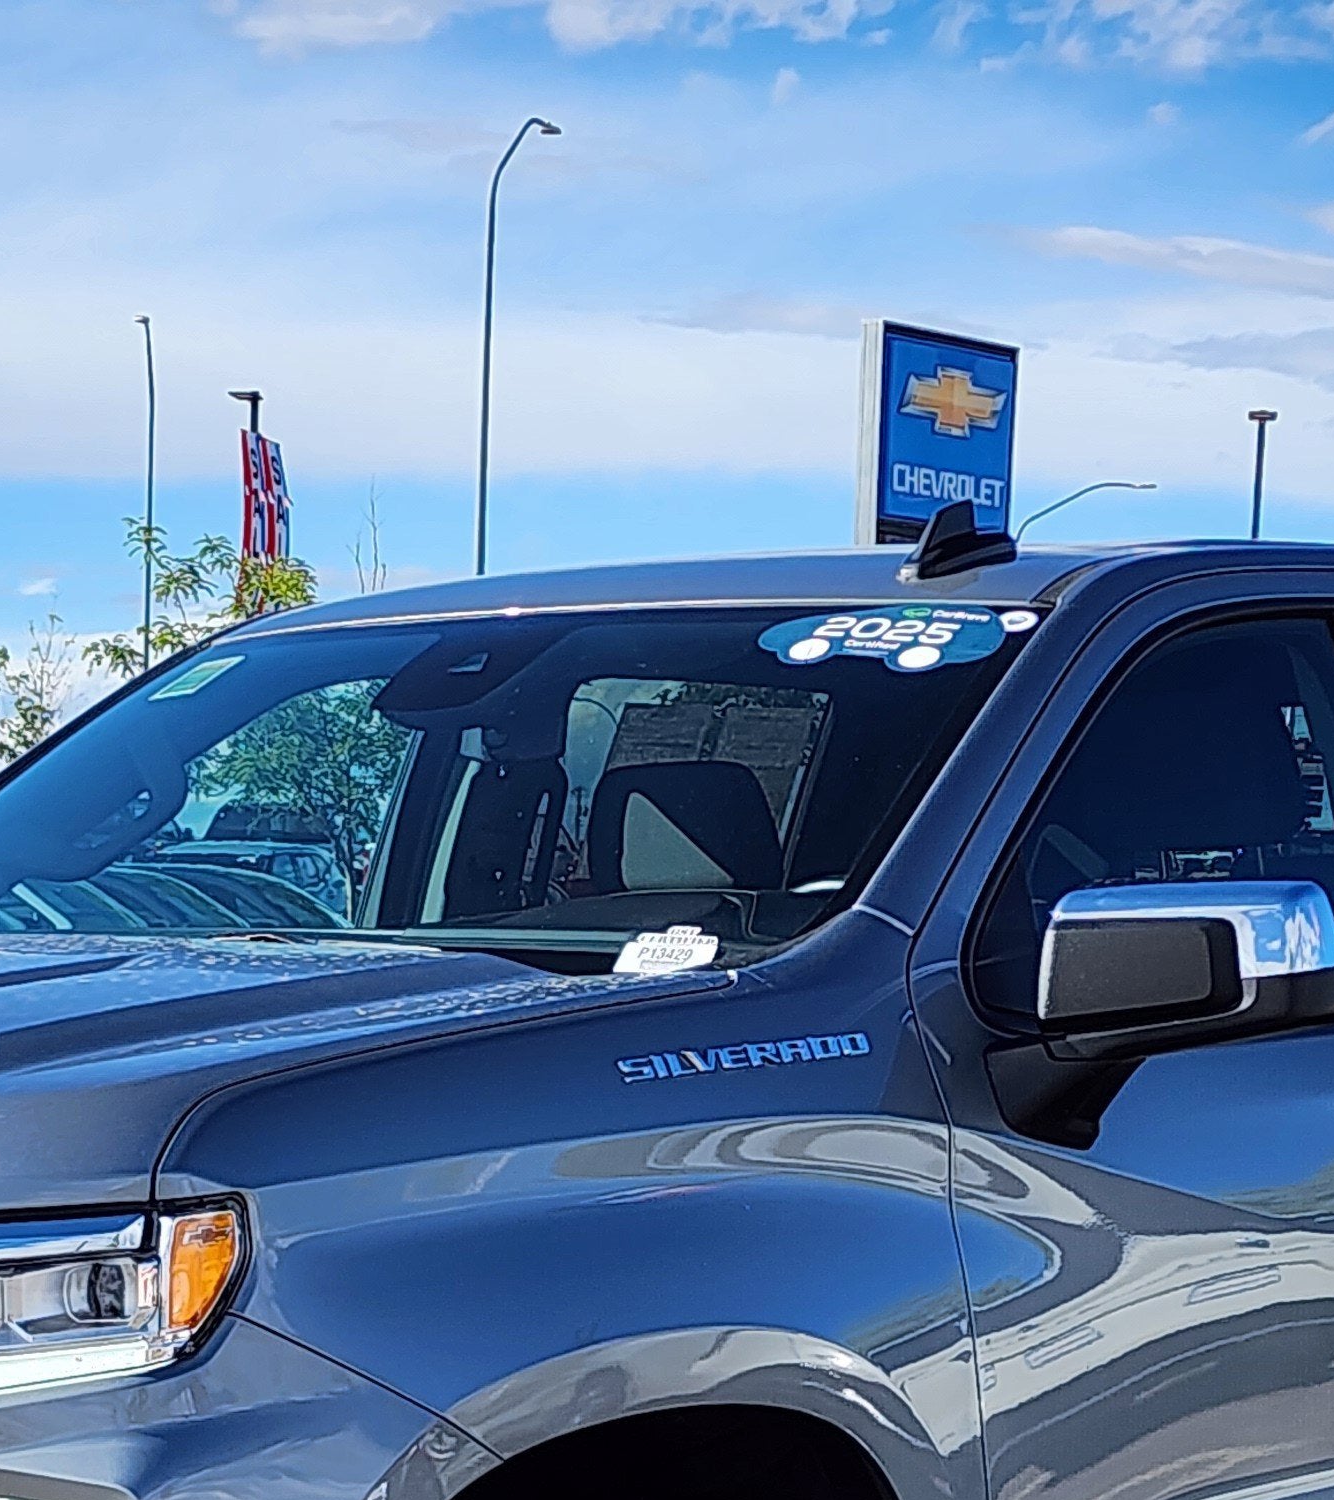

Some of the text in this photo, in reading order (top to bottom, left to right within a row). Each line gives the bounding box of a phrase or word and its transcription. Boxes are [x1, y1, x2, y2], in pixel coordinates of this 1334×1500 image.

[893, 463, 1005, 508] CHEVROLET
[812, 616, 963, 645] 2025
[637, 946, 694, 961] P13429
[618, 1032, 870, 1083] SILVERADO
